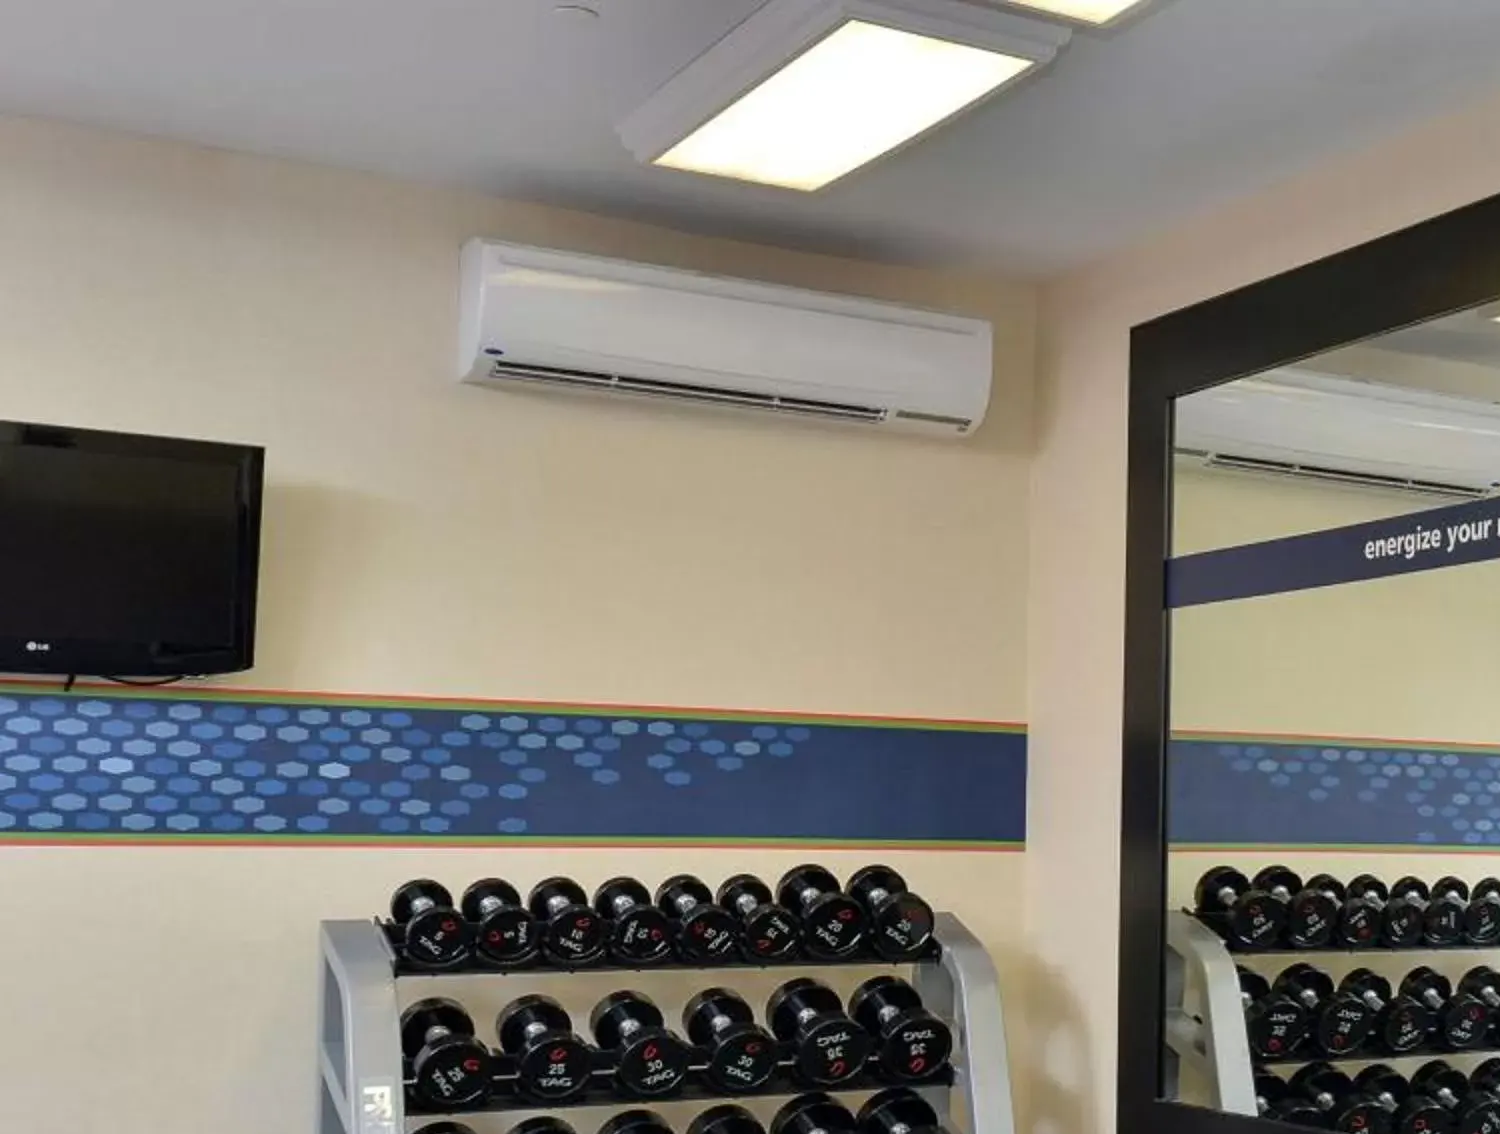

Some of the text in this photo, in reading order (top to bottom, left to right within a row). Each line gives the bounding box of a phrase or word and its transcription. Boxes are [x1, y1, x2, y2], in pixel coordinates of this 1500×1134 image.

[1364, 525, 1441, 559] energize
[1446, 518, 1493, 552] your
[816, 1031, 851, 1047] TAG
[903, 1029, 937, 1042] TAG
[647, 1059, 663, 1073] 30
[737, 1055, 753, 1067] 30
[641, 1069, 675, 1085] TAG
[725, 1065, 753, 1081] TAG
[538, 1077, 573, 1088] TAG
